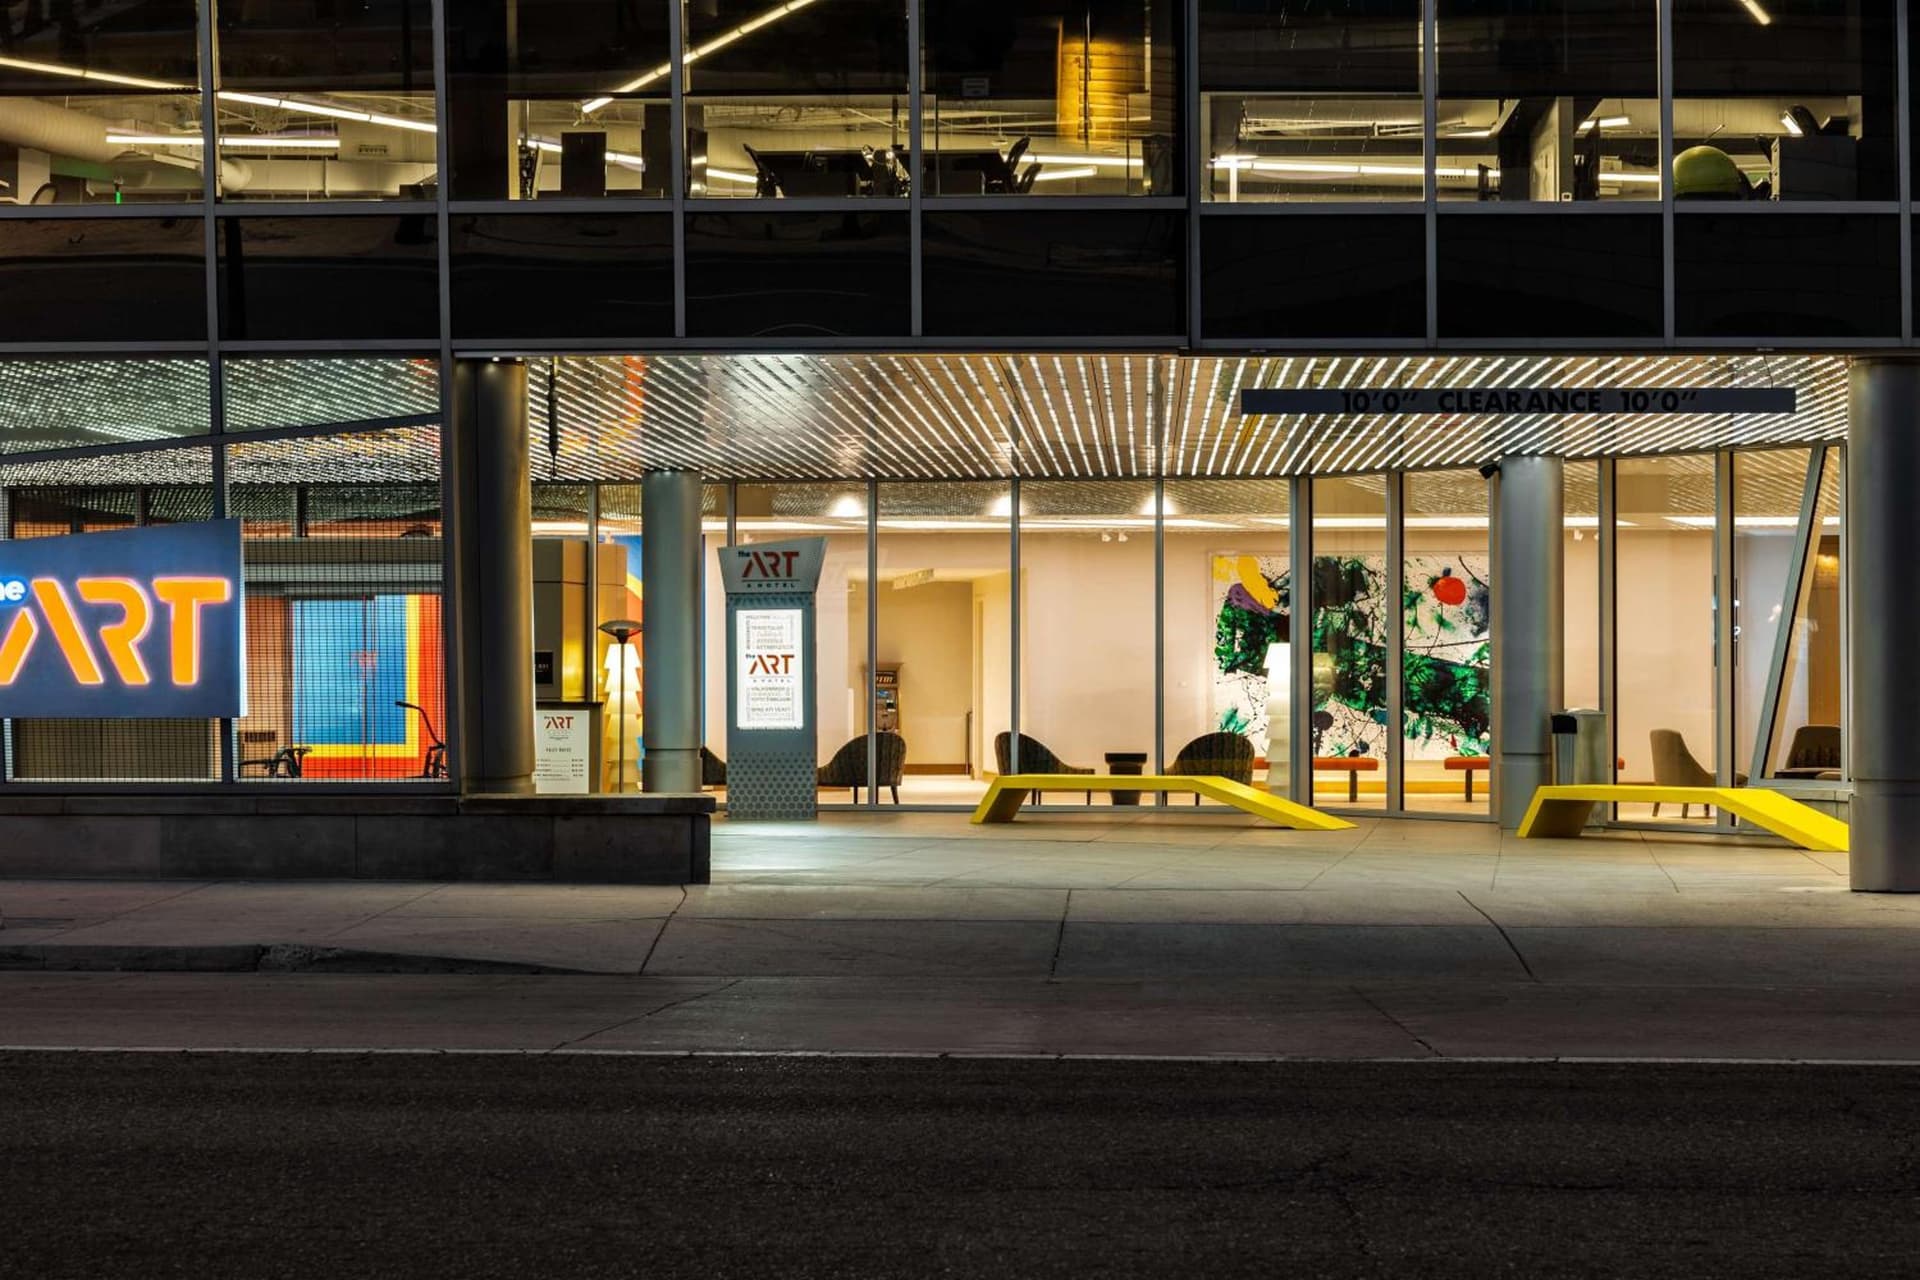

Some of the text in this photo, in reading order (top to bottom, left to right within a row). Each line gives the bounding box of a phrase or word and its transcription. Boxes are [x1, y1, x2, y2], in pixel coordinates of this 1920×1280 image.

[1437, 391, 1602, 413] CLEARANCE
[742, 551, 800, 577] ART
[0, 577, 231, 685] ART
[749, 654, 795, 674] ART
[546, 716, 574, 729] ART
